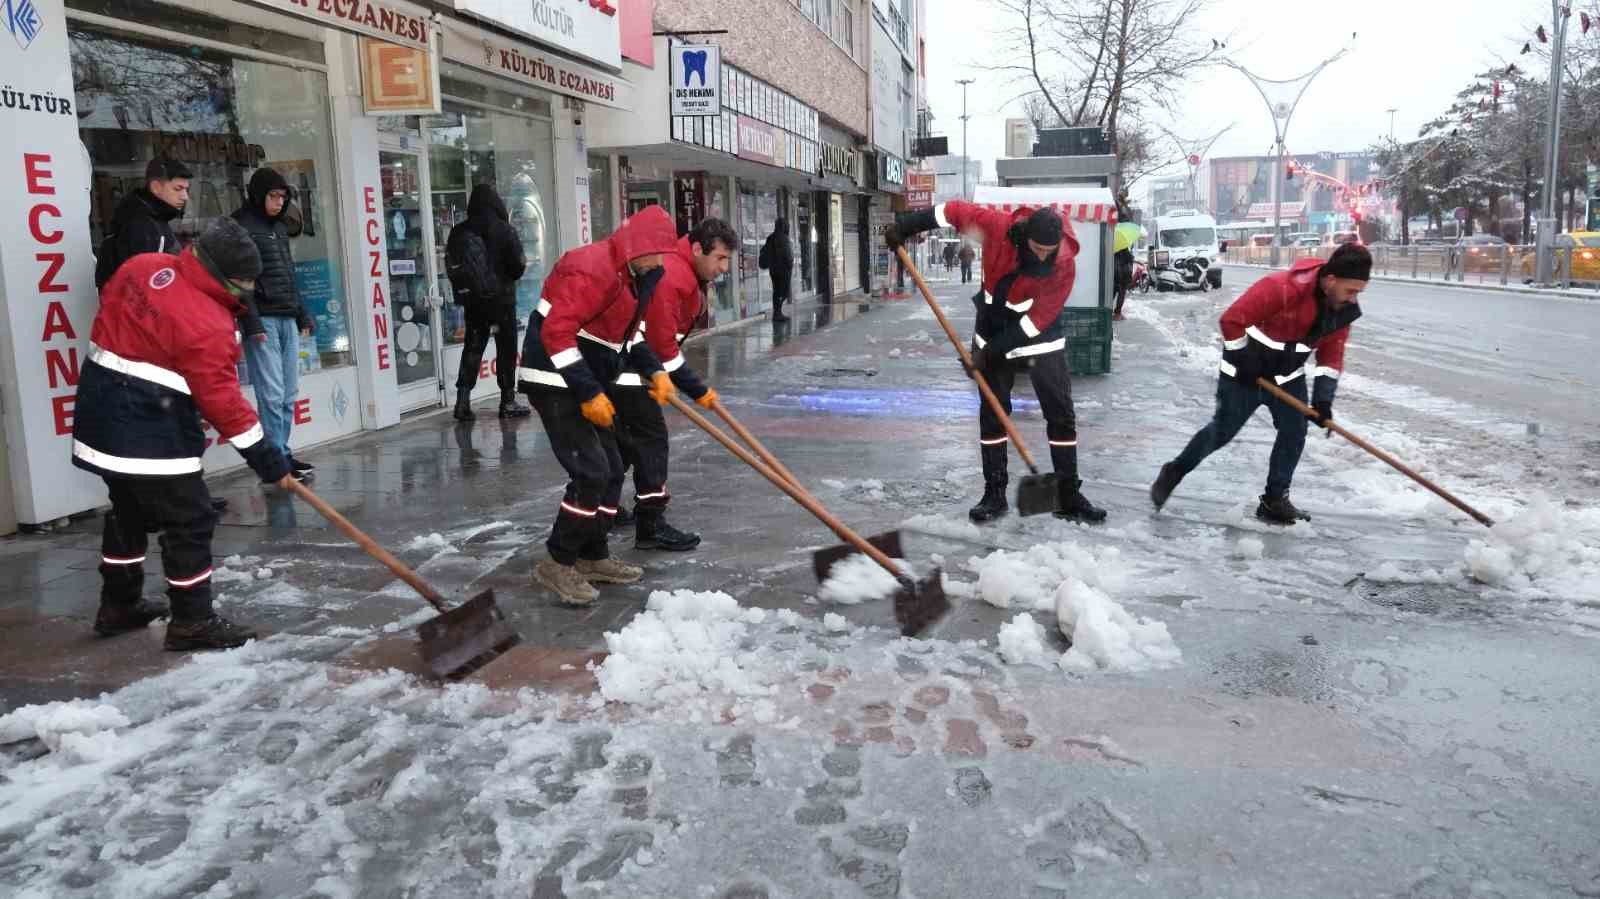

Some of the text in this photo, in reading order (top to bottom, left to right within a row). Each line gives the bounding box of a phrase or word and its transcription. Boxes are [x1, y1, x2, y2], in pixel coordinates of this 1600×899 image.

[499, 49, 615, 102] KÜLTÜR ECZANESİ
[531, 0, 575, 39] KÜLTÜR
[24, 152, 80, 436] ECZANE
[363, 186, 391, 371] ECZANE
